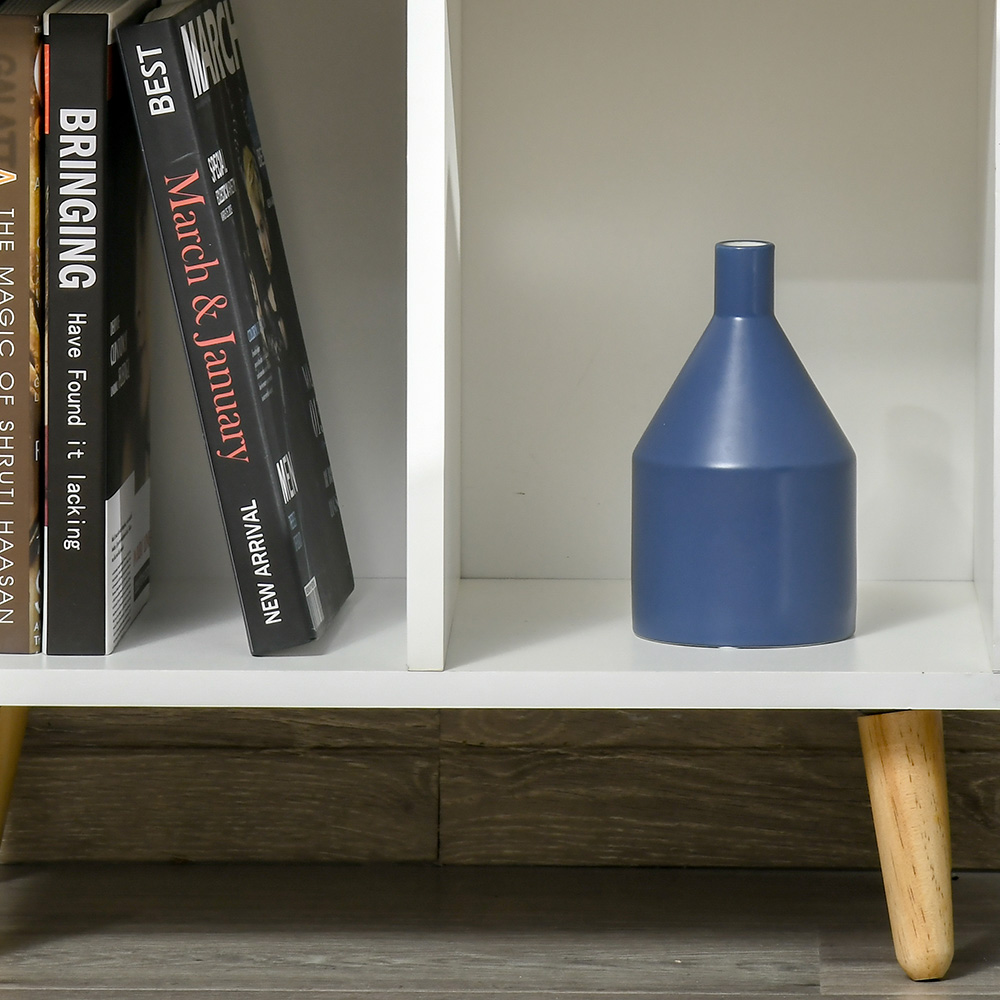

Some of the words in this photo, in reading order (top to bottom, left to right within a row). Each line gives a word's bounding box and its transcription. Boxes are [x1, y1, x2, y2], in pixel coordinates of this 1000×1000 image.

[136, 45, 176, 116] BEST
[58, 108, 98, 289] BRINGING
[164, 169, 219, 286] March
[67, 313, 88, 358] Have
[191, 295, 228, 325] &
[67, 369, 88, 426] Found
[193, 332, 250, 463] January
[67, 440, 87, 460] it
[63, 475, 87, 551] lacking
[240, 499, 272, 577] ARRIVAL
[257, 583, 282, 625] NEW
